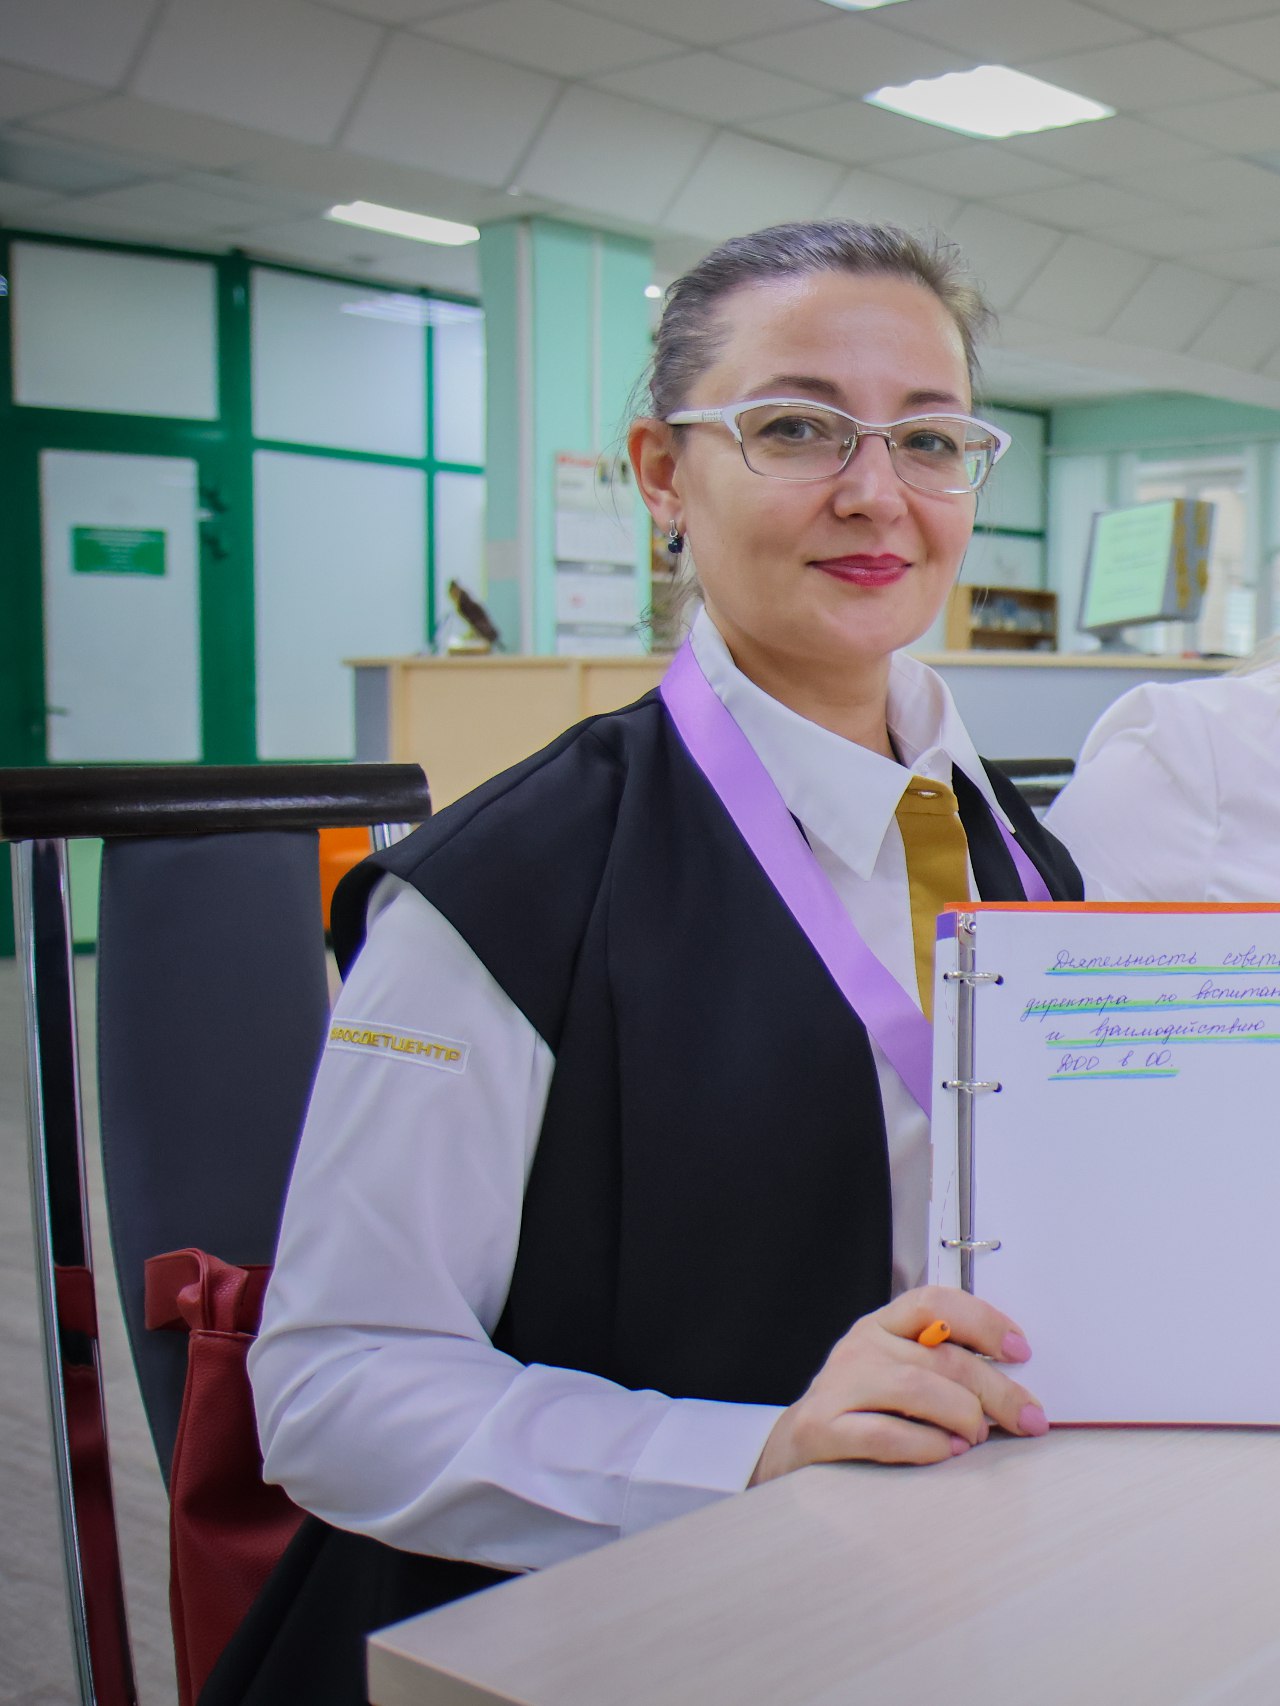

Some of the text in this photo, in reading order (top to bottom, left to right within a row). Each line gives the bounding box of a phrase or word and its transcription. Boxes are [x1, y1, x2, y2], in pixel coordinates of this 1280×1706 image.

[1052, 950, 1197, 970] Деятельность
[1020, 992, 1128, 1022] директора
[1155, 992, 1178, 1005] по
[1047, 1030, 1065, 1041] и
[1089, 1017, 1266, 1048] взаимодействию
